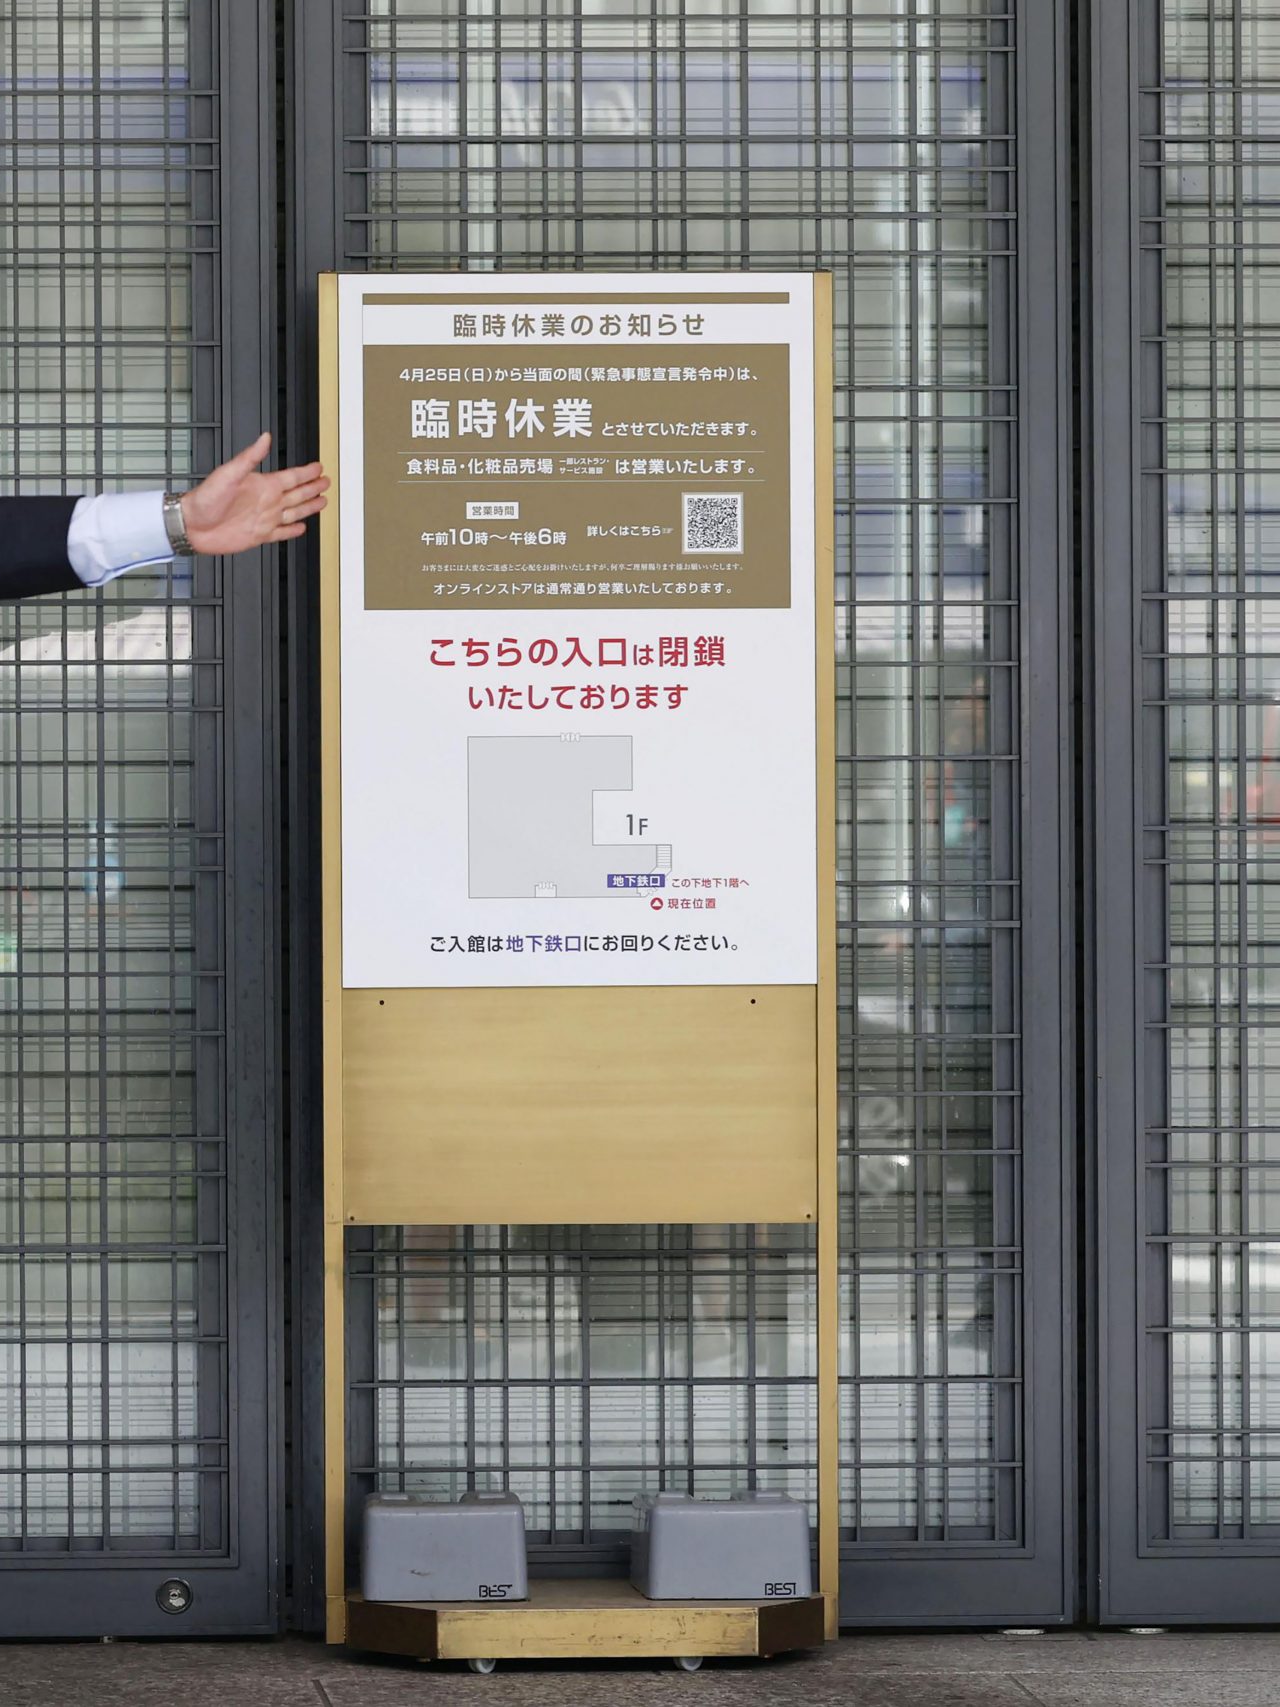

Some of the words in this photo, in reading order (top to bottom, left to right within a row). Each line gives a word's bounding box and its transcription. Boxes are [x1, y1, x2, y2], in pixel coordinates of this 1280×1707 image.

[453, 312, 705, 338] 臨時休業のお知らせ
[411, 398, 593, 439] 臨時休業
[406, 457, 554, 475] 食料品・化粧品売場
[615, 458, 755, 475] は営業いたします。
[472, 505, 515, 516] 営業時間
[587, 525, 662, 537] 詳しくはこちら
[433, 582, 733, 595] オンラインストアは通常通り営業いたしております。
[429, 635, 726, 668] こちらの入口は閉鎖
[468, 683, 689, 710] いたしております
[625, 813, 649, 836] 1F
[612, 875, 661, 888] 地下鉄口
[671, 877, 750, 889] この下地下1階へ
[667, 898, 716, 910] 現在位置
[430, 934, 740, 954] ご入館は地下鉄口にお回りください。
[764, 1582, 797, 1596] BEST
